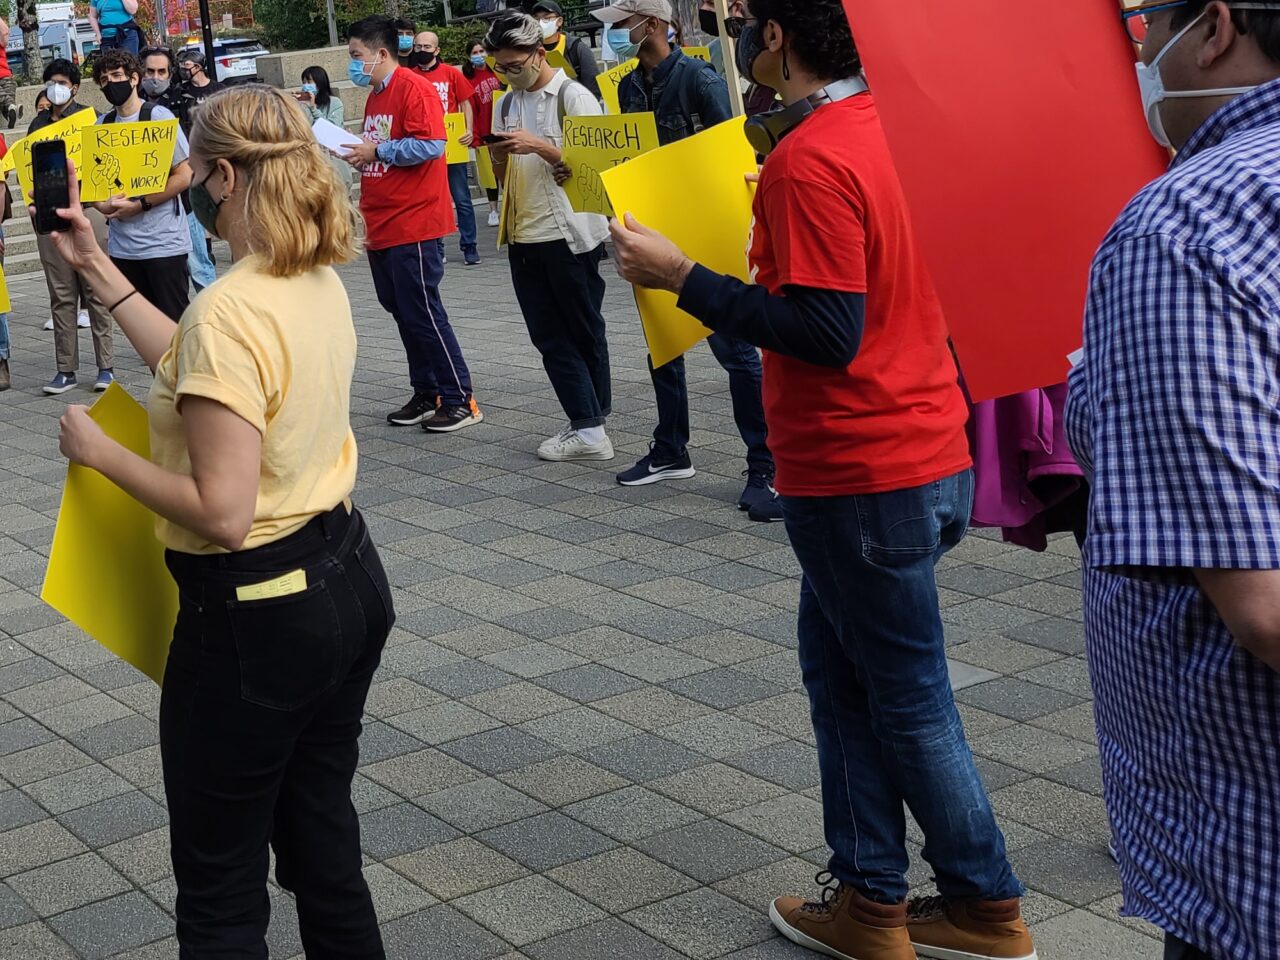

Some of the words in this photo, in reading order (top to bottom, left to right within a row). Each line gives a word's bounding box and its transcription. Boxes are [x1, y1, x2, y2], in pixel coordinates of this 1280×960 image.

[95, 126, 173, 148] RESEARCH
[563, 119, 640, 150] RESEARCH
[142, 150, 158, 168] IS
[131, 171, 166, 190] WORK!
